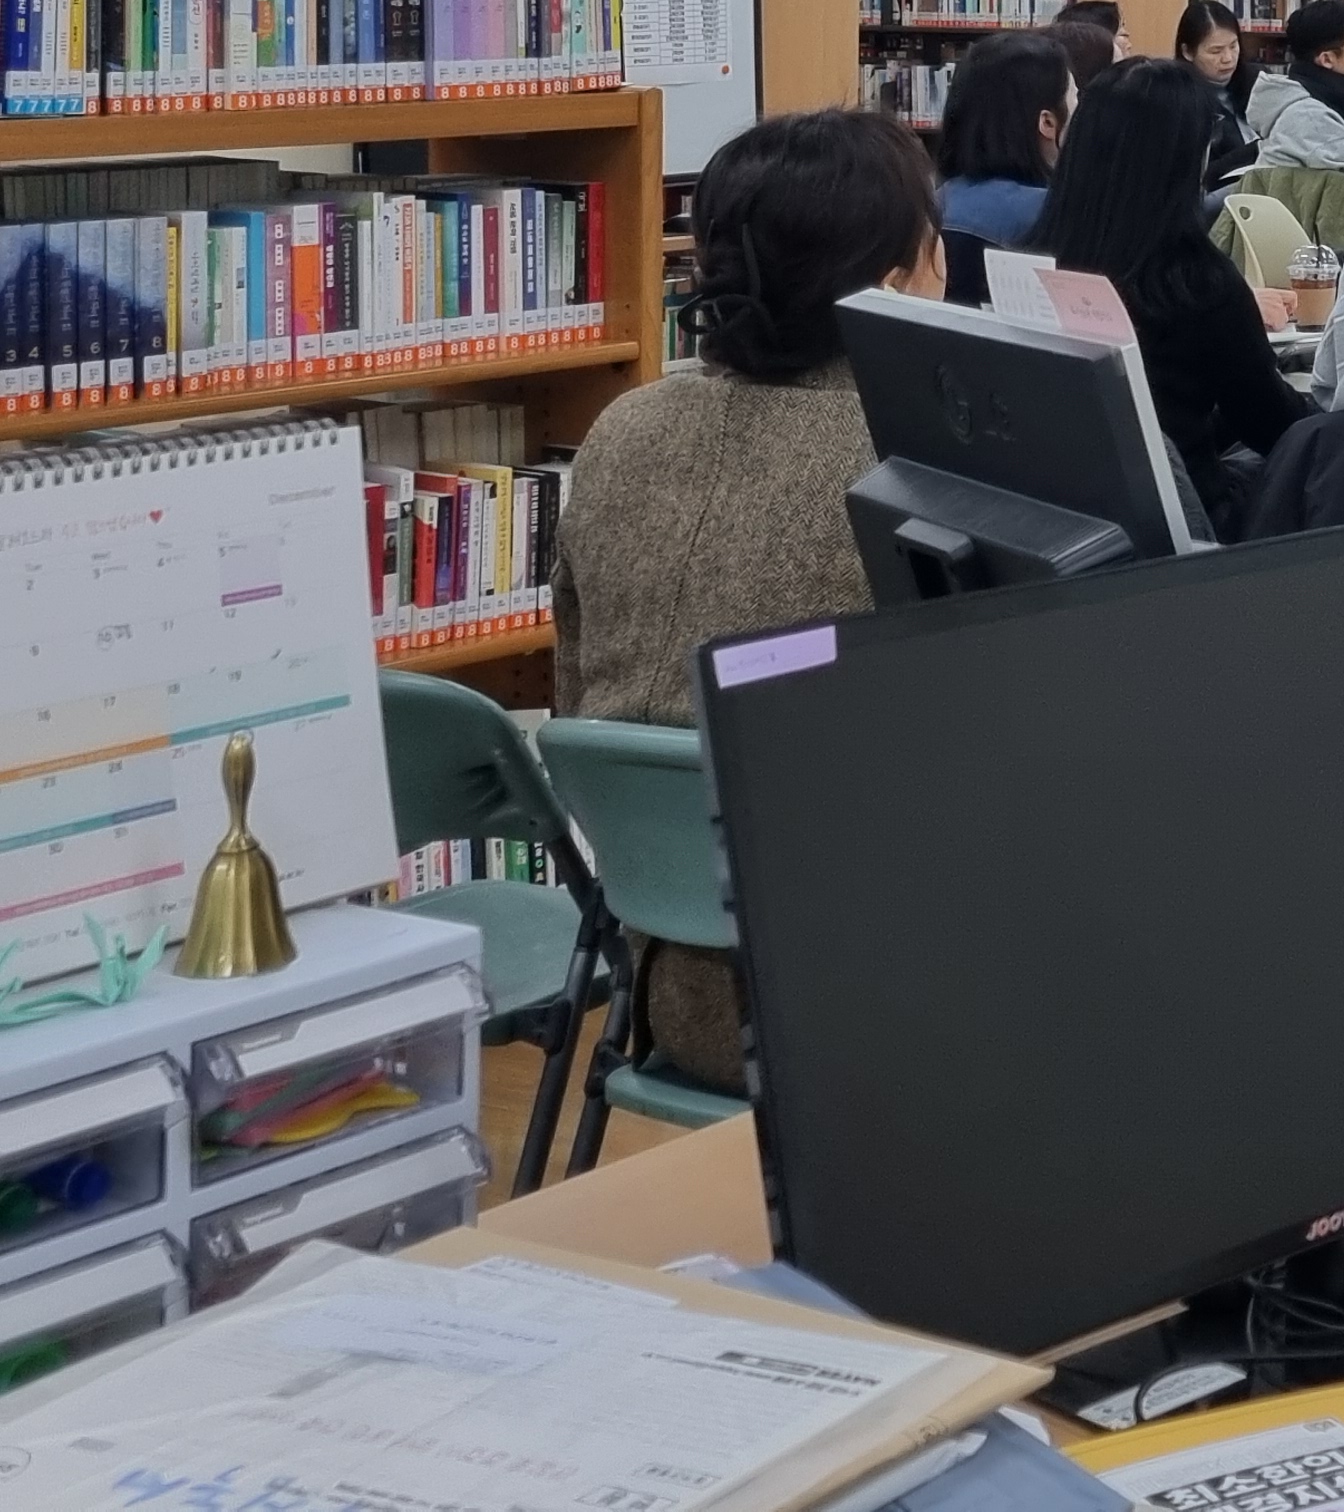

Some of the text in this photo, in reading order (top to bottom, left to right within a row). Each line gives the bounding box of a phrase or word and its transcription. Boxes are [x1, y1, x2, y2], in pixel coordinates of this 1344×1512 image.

[576, 77, 584, 89] 8
[589, 76, 597, 88] 8
[598, 75, 606, 87] 8
[606, 75, 613, 86] 8
[613, 73, 621, 85] 8
[459, 86, 467, 98] 8
[476, 85, 484, 97] 8
[494, 84, 500, 96] 8
[506, 83, 514, 95] 8
[518, 82, 526, 94] 8
[530, 82, 538, 94] 8
[544, 82, 551, 93] 8
[553, 80, 561, 92] 8
[561, 81, 569, 93] 8
[288, 92, 295, 105] 8
[298, 92, 306, 104] 8
[308, 92, 316, 104] 8
[320, 91, 328, 103] 8
[333, 90, 341, 102] 8
[349, 89, 357, 101] 8
[364, 89, 372, 101] 8
[377, 89, 385, 101] 8
[394, 88, 401, 100] 8
[413, 87, 420, 98] 8
[441, 87, 449, 99] 8
[30, 100, 38, 110] 7
[42, 100, 50, 110] 7
[58, 99, 66, 110] 7
[71, 98, 78, 110] 7
[132, 99, 140, 111] 8
[161, 98, 169, 110] 8
[176, 98, 184, 110] 8
[192, 96, 201, 109] 8
[214, 96, 222, 108] 8
[239, 95, 247, 108] 8
[263, 94, 271, 106] 8
[277, 93, 285, 105] 8
[14, 100, 22, 111] 7
[88, 101, 96, 113] 8
[113, 100, 121, 112] 8
[552, 332, 558, 343] 8
[563, 330, 571, 342] 8
[578, 328, 585, 340] 8
[594, 327, 600, 338] 8
[119, 339, 129, 351] 7
[152, 337, 161, 348] 8
[488, 338, 495, 350] 8
[511, 337, 518, 348] 8
[528, 334, 535, 346] 8
[538, 333, 546, 345] 8
[62, 346, 72, 357] 5
[90, 342, 100, 353] 6
[418, 346, 426, 358] 8
[450, 343, 458, 354] 8
[460, 342, 468, 353] 8
[476, 340, 483, 352] 8
[6, 350, 16, 362] 3
[29, 347, 38, 358] 4
[394, 351, 402, 363] 8
[404, 350, 412, 361] 8
[327, 358, 335, 370] 8
[344, 356, 352, 368] 8
[364, 356, 372, 368] 8
[376, 353, 384, 365] 8
[256, 367, 264, 379] 8
[275, 364, 284, 376] 8
[305, 361, 312, 373] 8
[222, 370, 230, 382] 8
[237, 369, 244, 381] 8
[152, 383, 161, 395] 8
[190, 378, 198, 390] 8
[91, 390, 99, 402] 8
[120, 386, 127, 398] 8
[7, 399, 15, 411] 8
[31, 396, 38, 408] 8
[63, 393, 71, 405] 8
